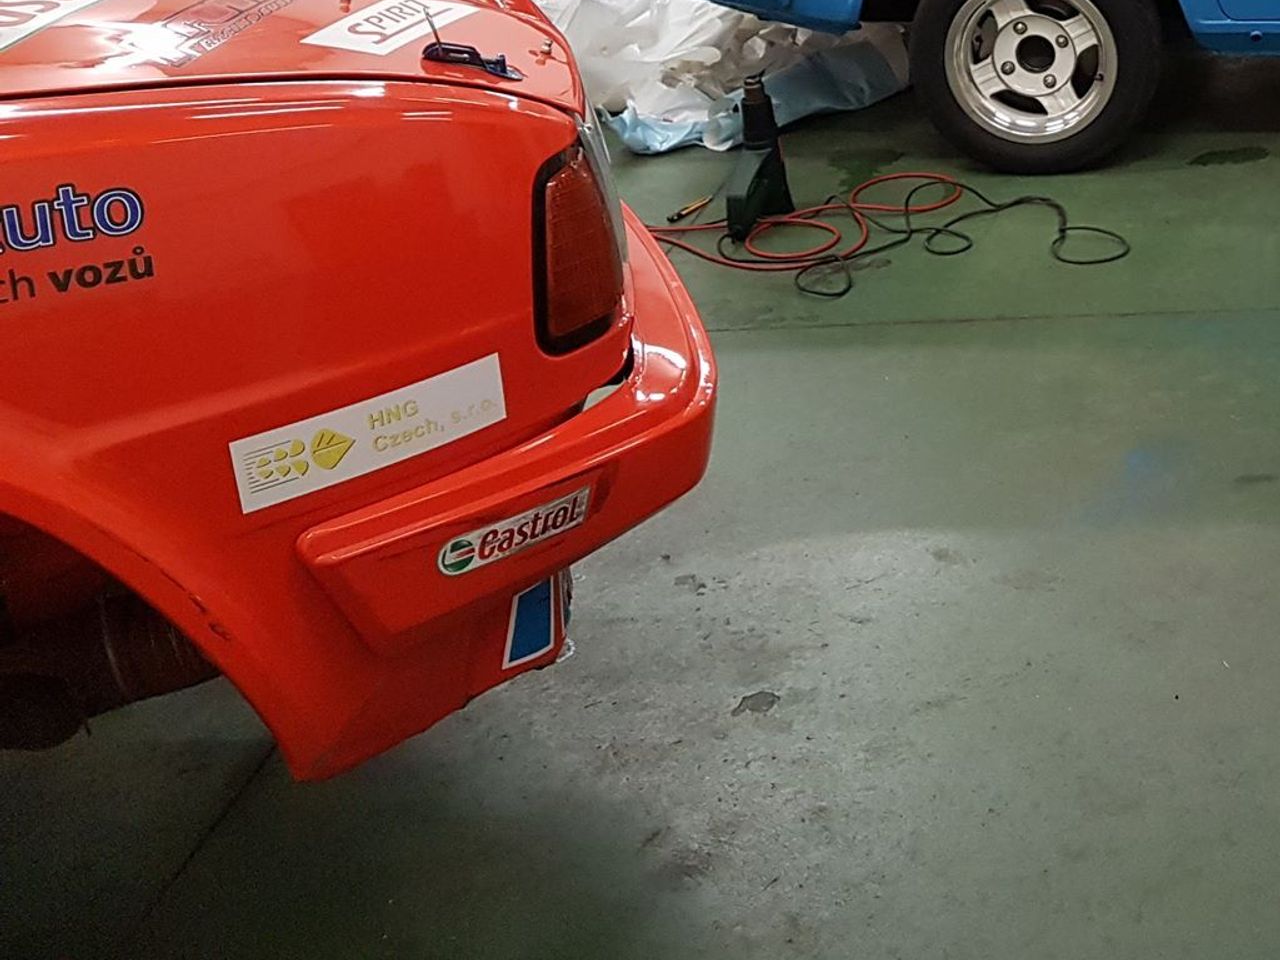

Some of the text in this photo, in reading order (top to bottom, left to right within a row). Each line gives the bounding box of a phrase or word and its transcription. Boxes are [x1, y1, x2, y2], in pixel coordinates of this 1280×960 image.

[0, 184, 144, 253] uto
[48, 246, 154, 293] vozů
[367, 399, 419, 430] HNG
[373, 417, 445, 453] Czech,
[478, 495, 579, 561] Castrol
